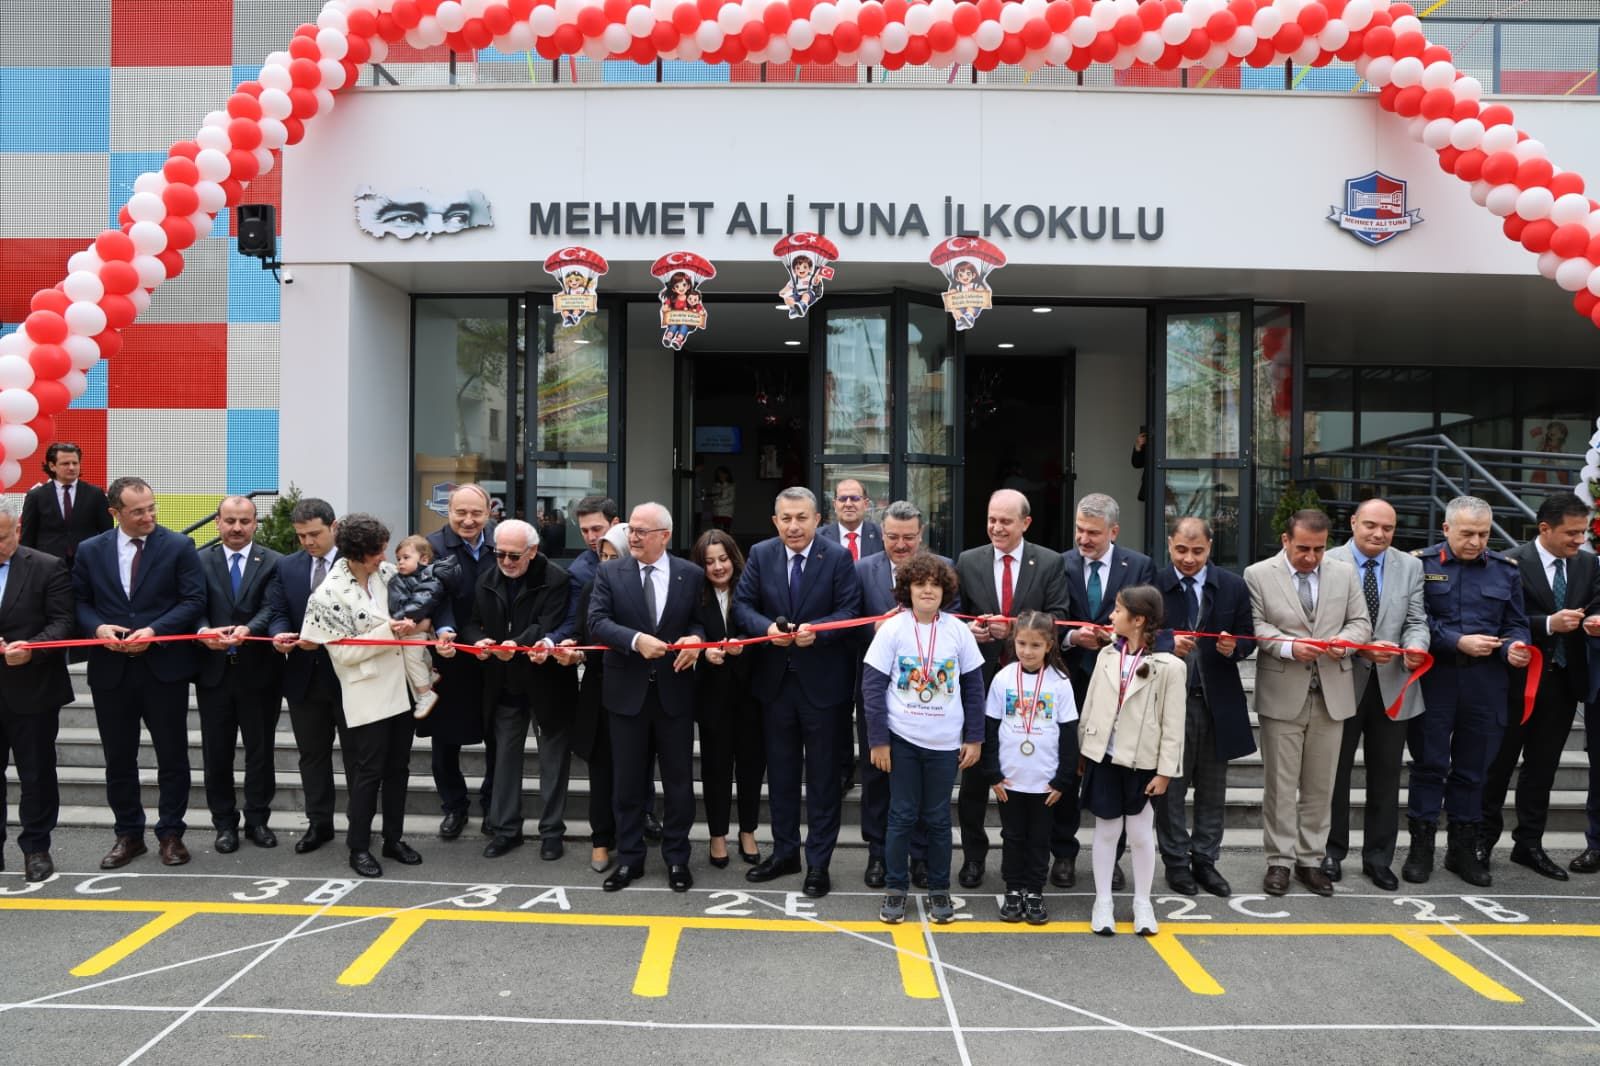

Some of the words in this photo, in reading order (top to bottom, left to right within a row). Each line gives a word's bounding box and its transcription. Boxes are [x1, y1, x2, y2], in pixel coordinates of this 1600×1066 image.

[529, 201, 714, 235] MEHMET
[726, 194, 794, 236] ALİ
[809, 202, 929, 236] TUNA
[945, 195, 1164, 240] İLKOKULU
[1344, 217, 1374, 227] MEHMET
[1388, 218, 1407, 226] TUNA
